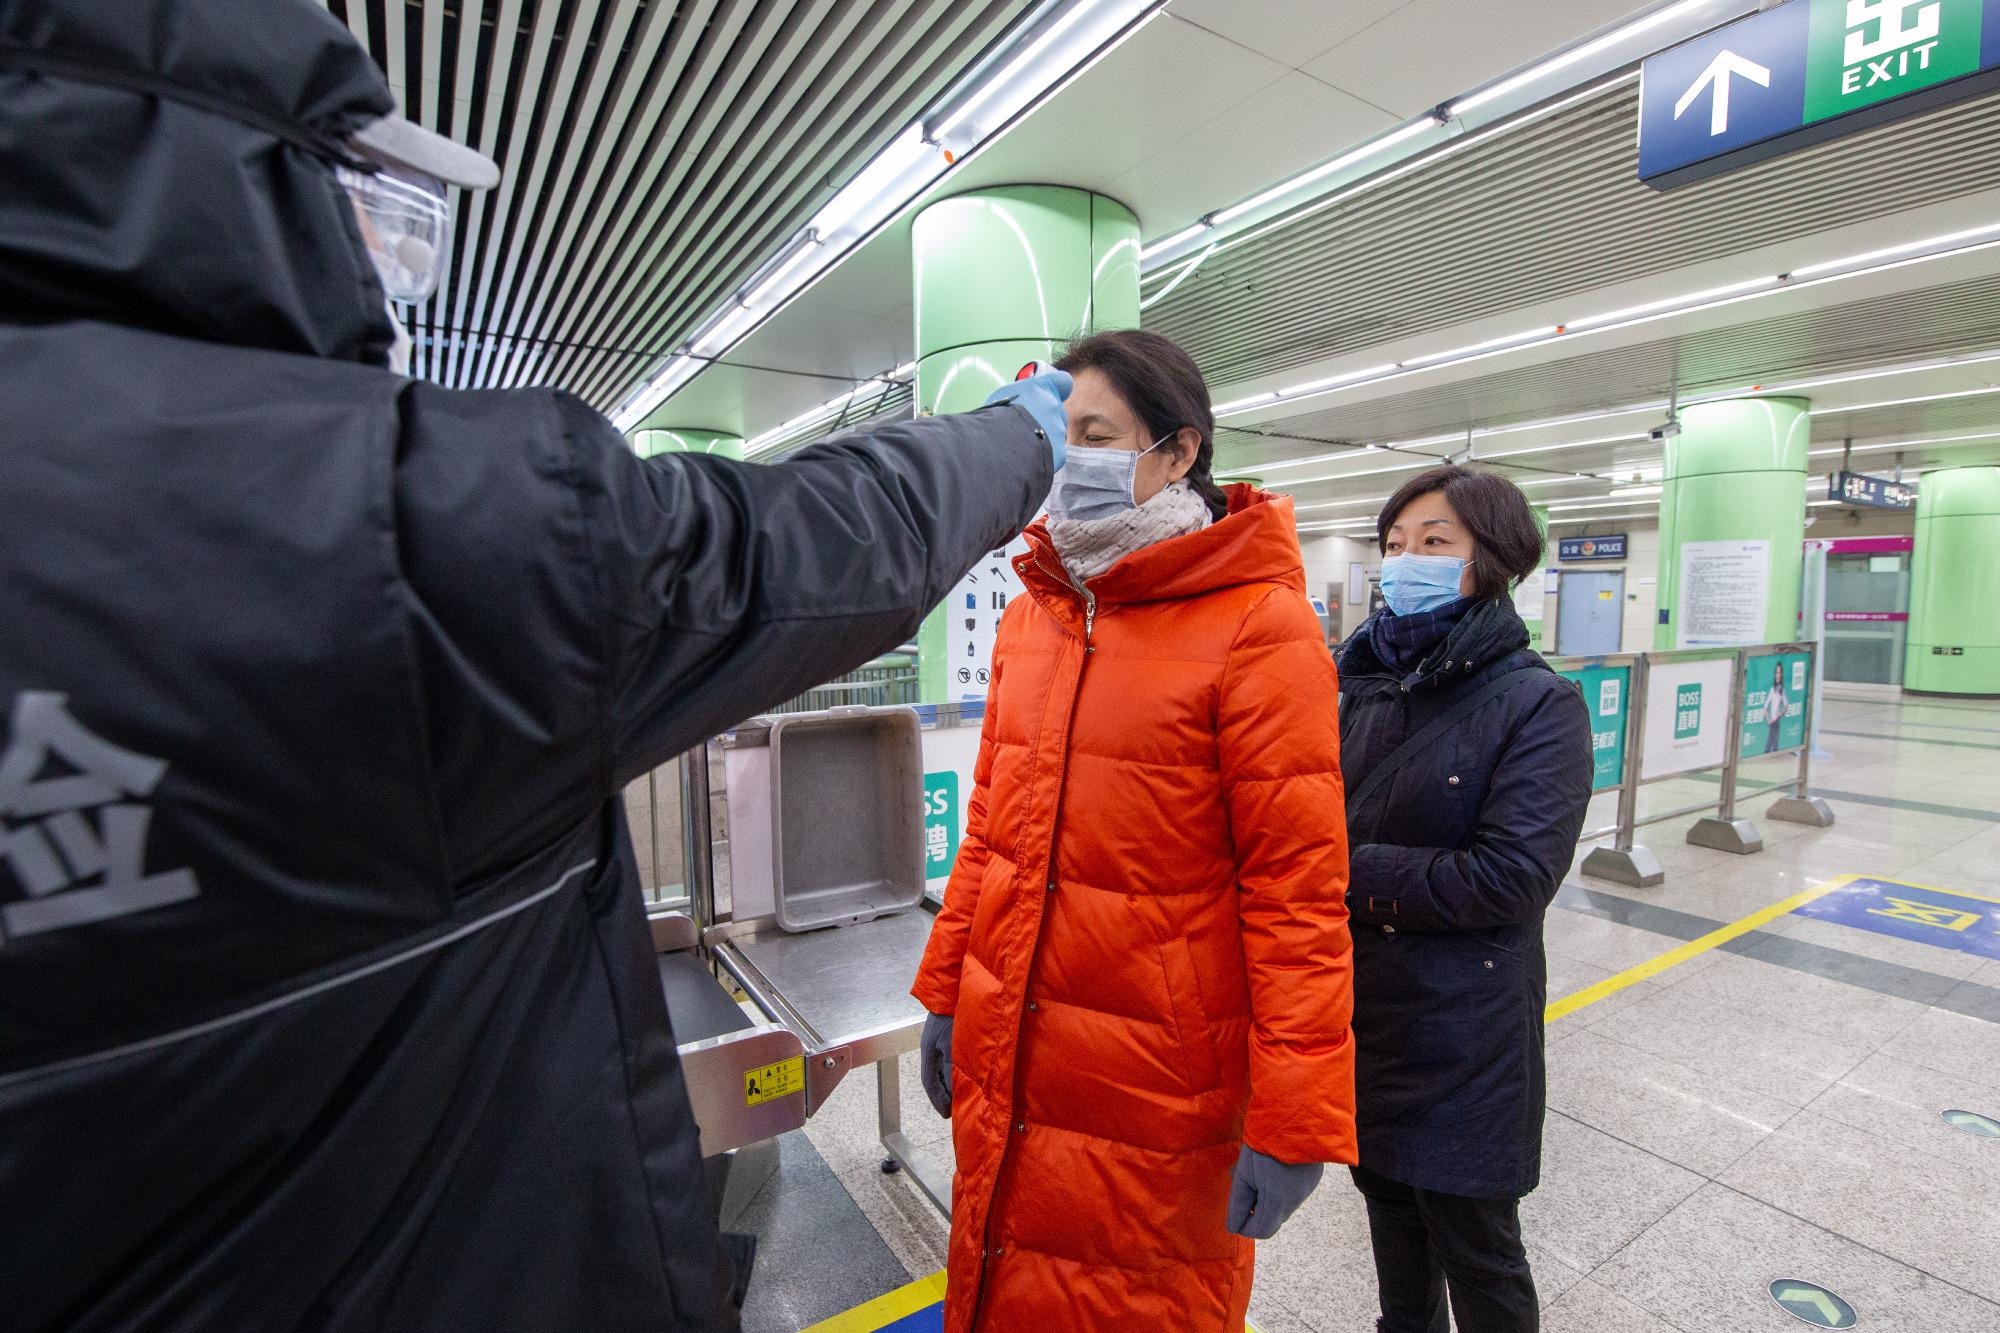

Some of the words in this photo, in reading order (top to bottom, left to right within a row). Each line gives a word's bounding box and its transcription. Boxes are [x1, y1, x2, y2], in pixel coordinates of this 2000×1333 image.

[1843, 0, 1940, 67] 出
[1841, 40, 1939, 95] EXIT
[1562, 545, 1579, 554] 公安
[1598, 543, 1623, 552] POLICE
[1603, 685, 1617, 694] BOSS
[1679, 691, 1700, 707] BOSS
[1677, 710, 1698, 731] 直聘
